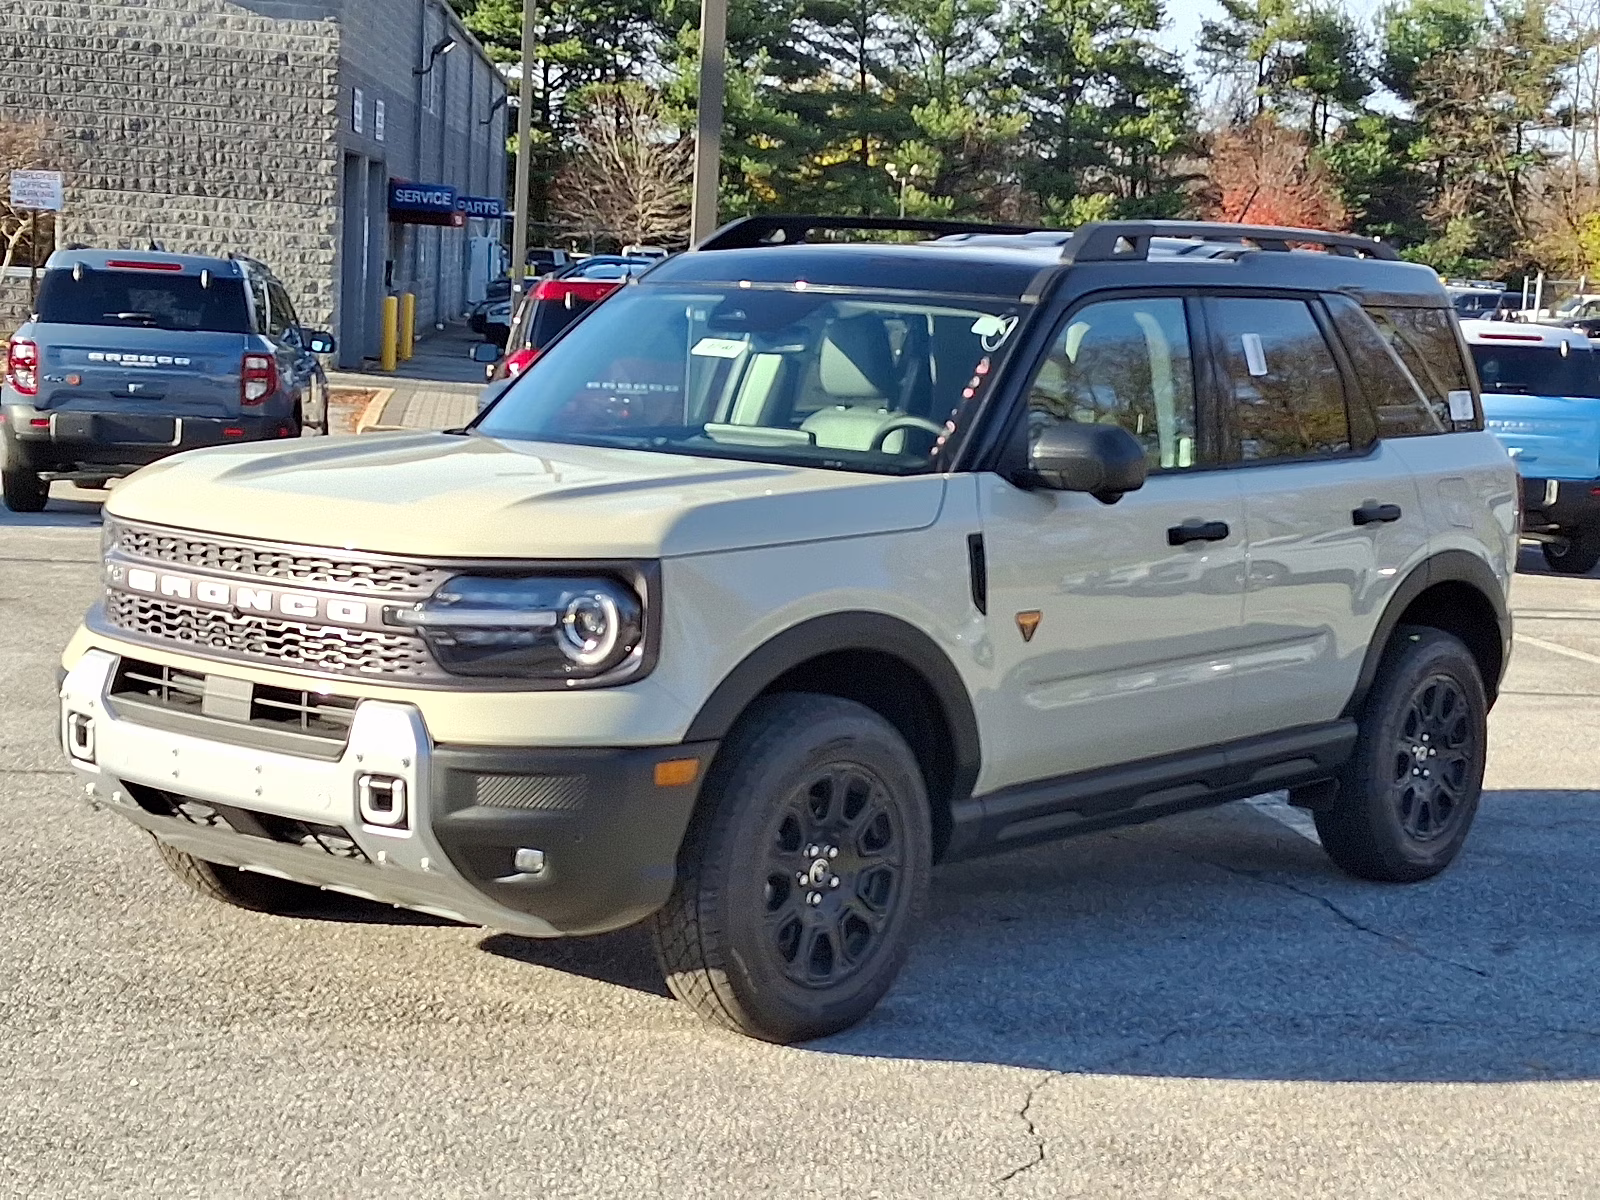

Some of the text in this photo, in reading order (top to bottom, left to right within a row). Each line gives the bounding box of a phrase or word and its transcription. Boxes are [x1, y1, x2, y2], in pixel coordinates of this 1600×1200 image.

[395, 189, 452, 206] SERVICE
[457, 200, 500, 215] PARTS
[127, 567, 368, 625] BRONCO
